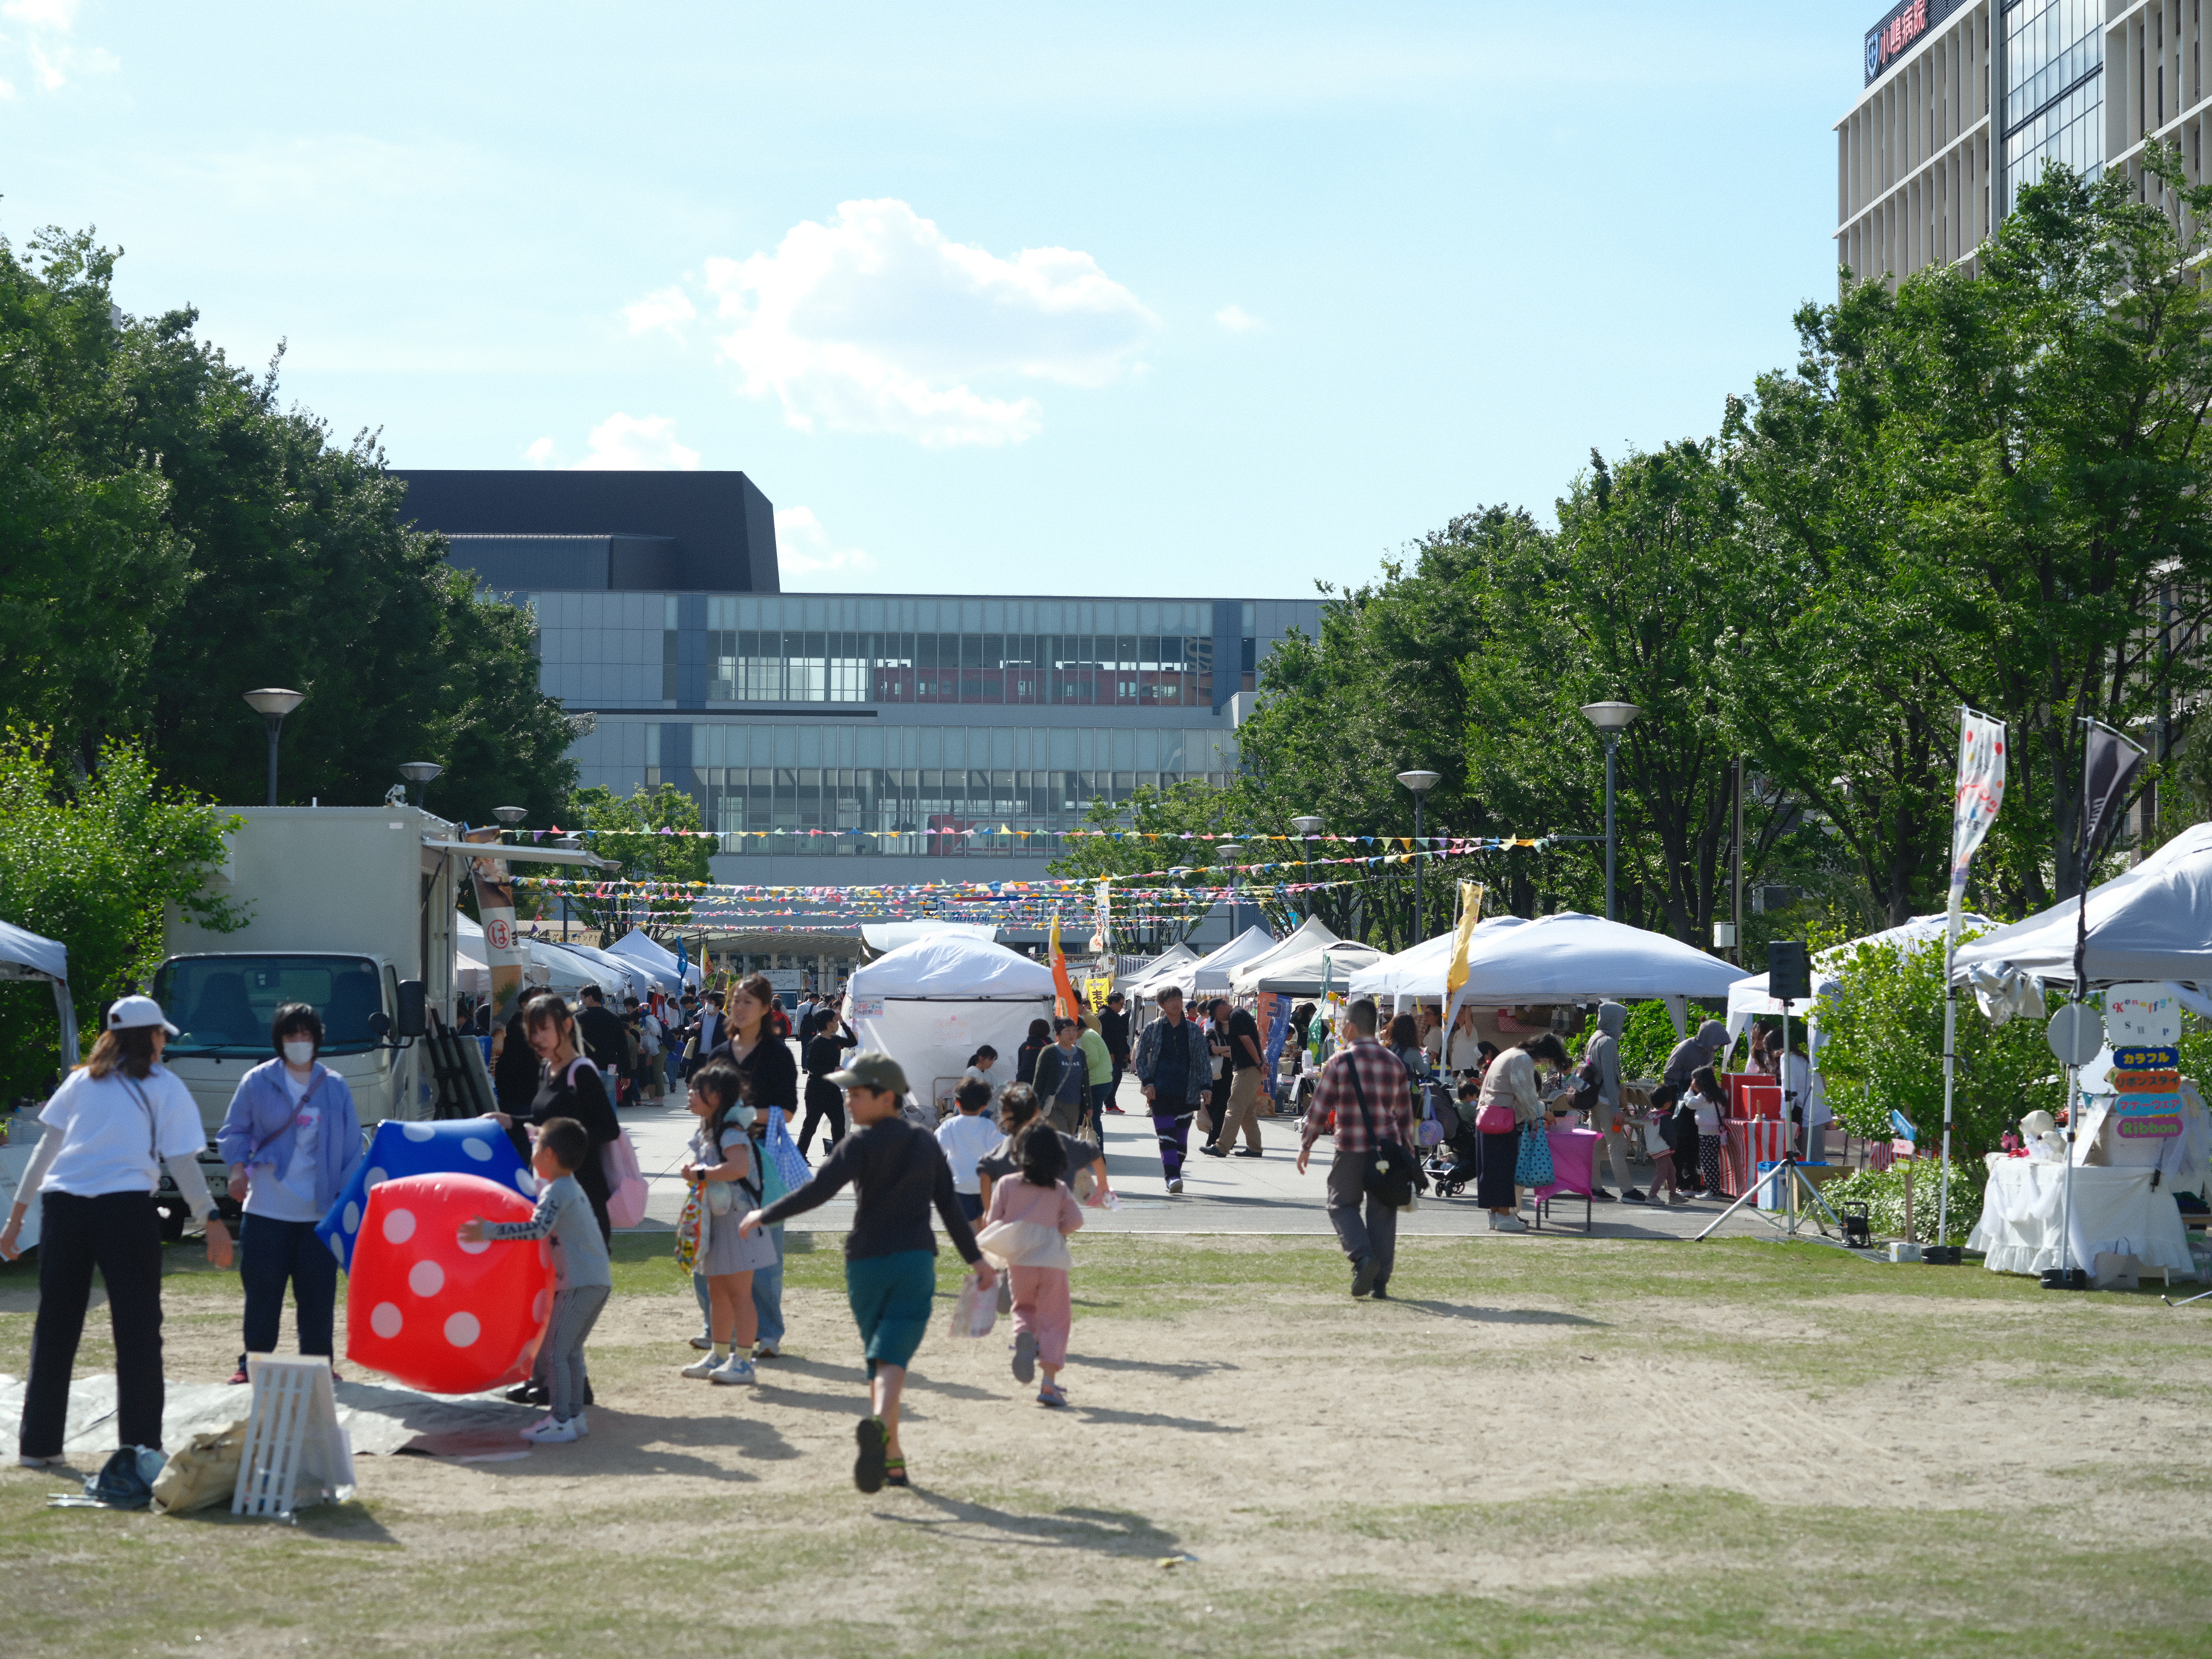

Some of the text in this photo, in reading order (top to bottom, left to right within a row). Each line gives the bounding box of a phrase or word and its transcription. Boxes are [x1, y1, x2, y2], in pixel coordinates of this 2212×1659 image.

[1880, 0, 1926, 64] 小嶋病院
[2123, 1052, 2170, 1065] カラフル
[2119, 1099, 2180, 1111] マナーウェア
[2122, 1121, 2178, 1135] Ribbon
